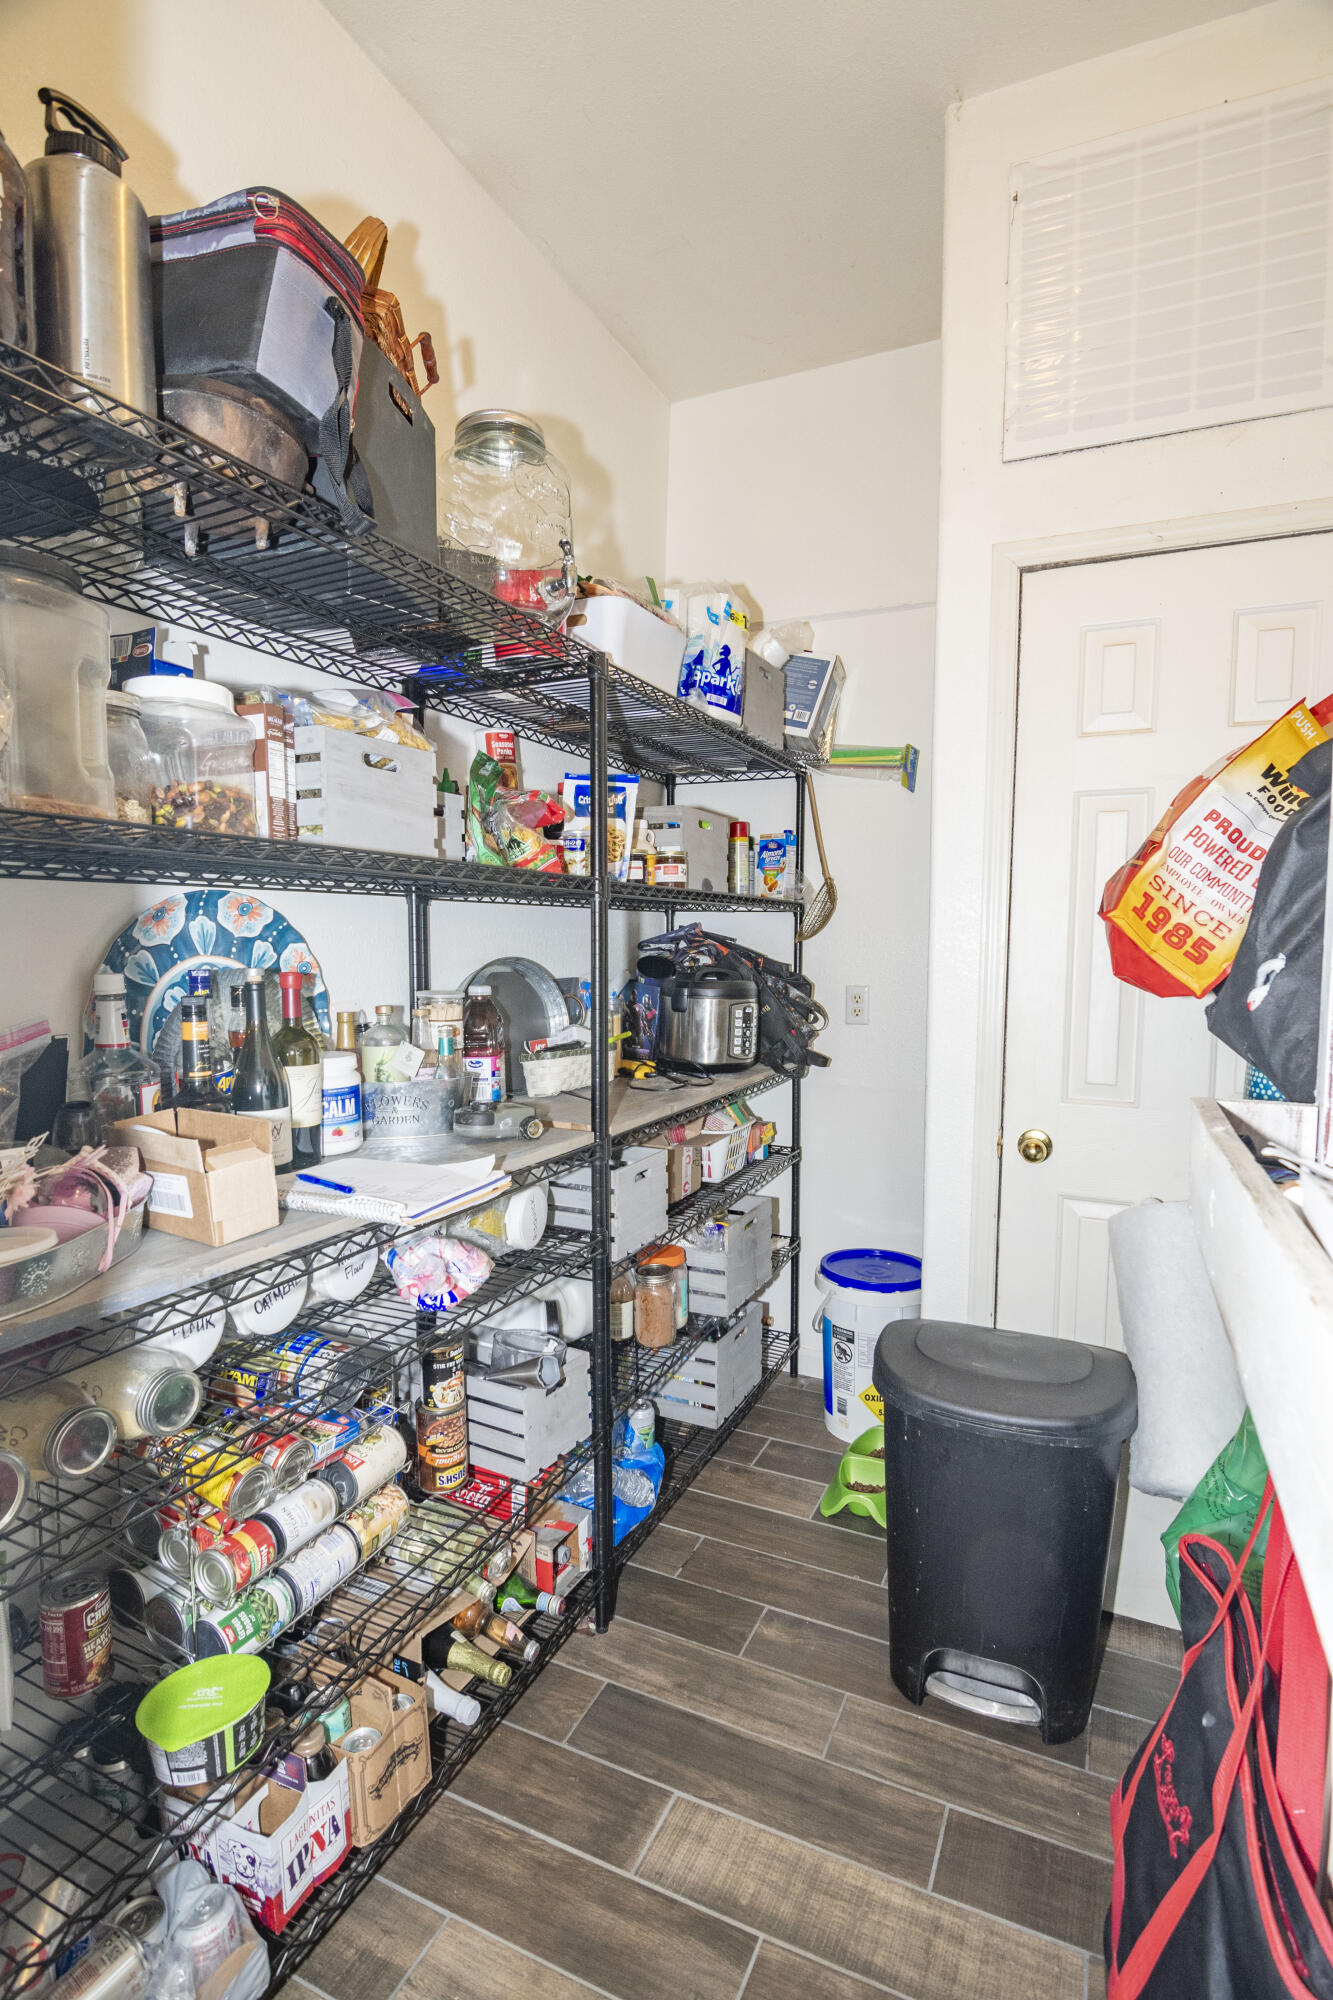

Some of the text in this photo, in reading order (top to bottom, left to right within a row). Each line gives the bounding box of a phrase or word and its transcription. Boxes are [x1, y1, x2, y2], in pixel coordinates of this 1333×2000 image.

[1291, 710, 1316, 740] PUSH
[1257, 785, 1298, 817] FOOD
[1260, 762, 1312, 808] WinC
[1187, 826, 1253, 881] POWERED
[1203, 809, 1266, 862] PROUD
[1168, 846, 1253, 913] OUR COMMUNIT
[1148, 874, 1232, 940] SINCE
[1132, 892, 1216, 966] 1985
[323, 1098, 355, 1118] CALM
[371, 1115, 421, 1125] GARDEN
[344, 1261, 366, 1280] Flour
[231, 1617, 246, 1641] Green
[238, 1611, 254, 1637] Beans
[289, 1799, 337, 1852] LAGUNITAS
